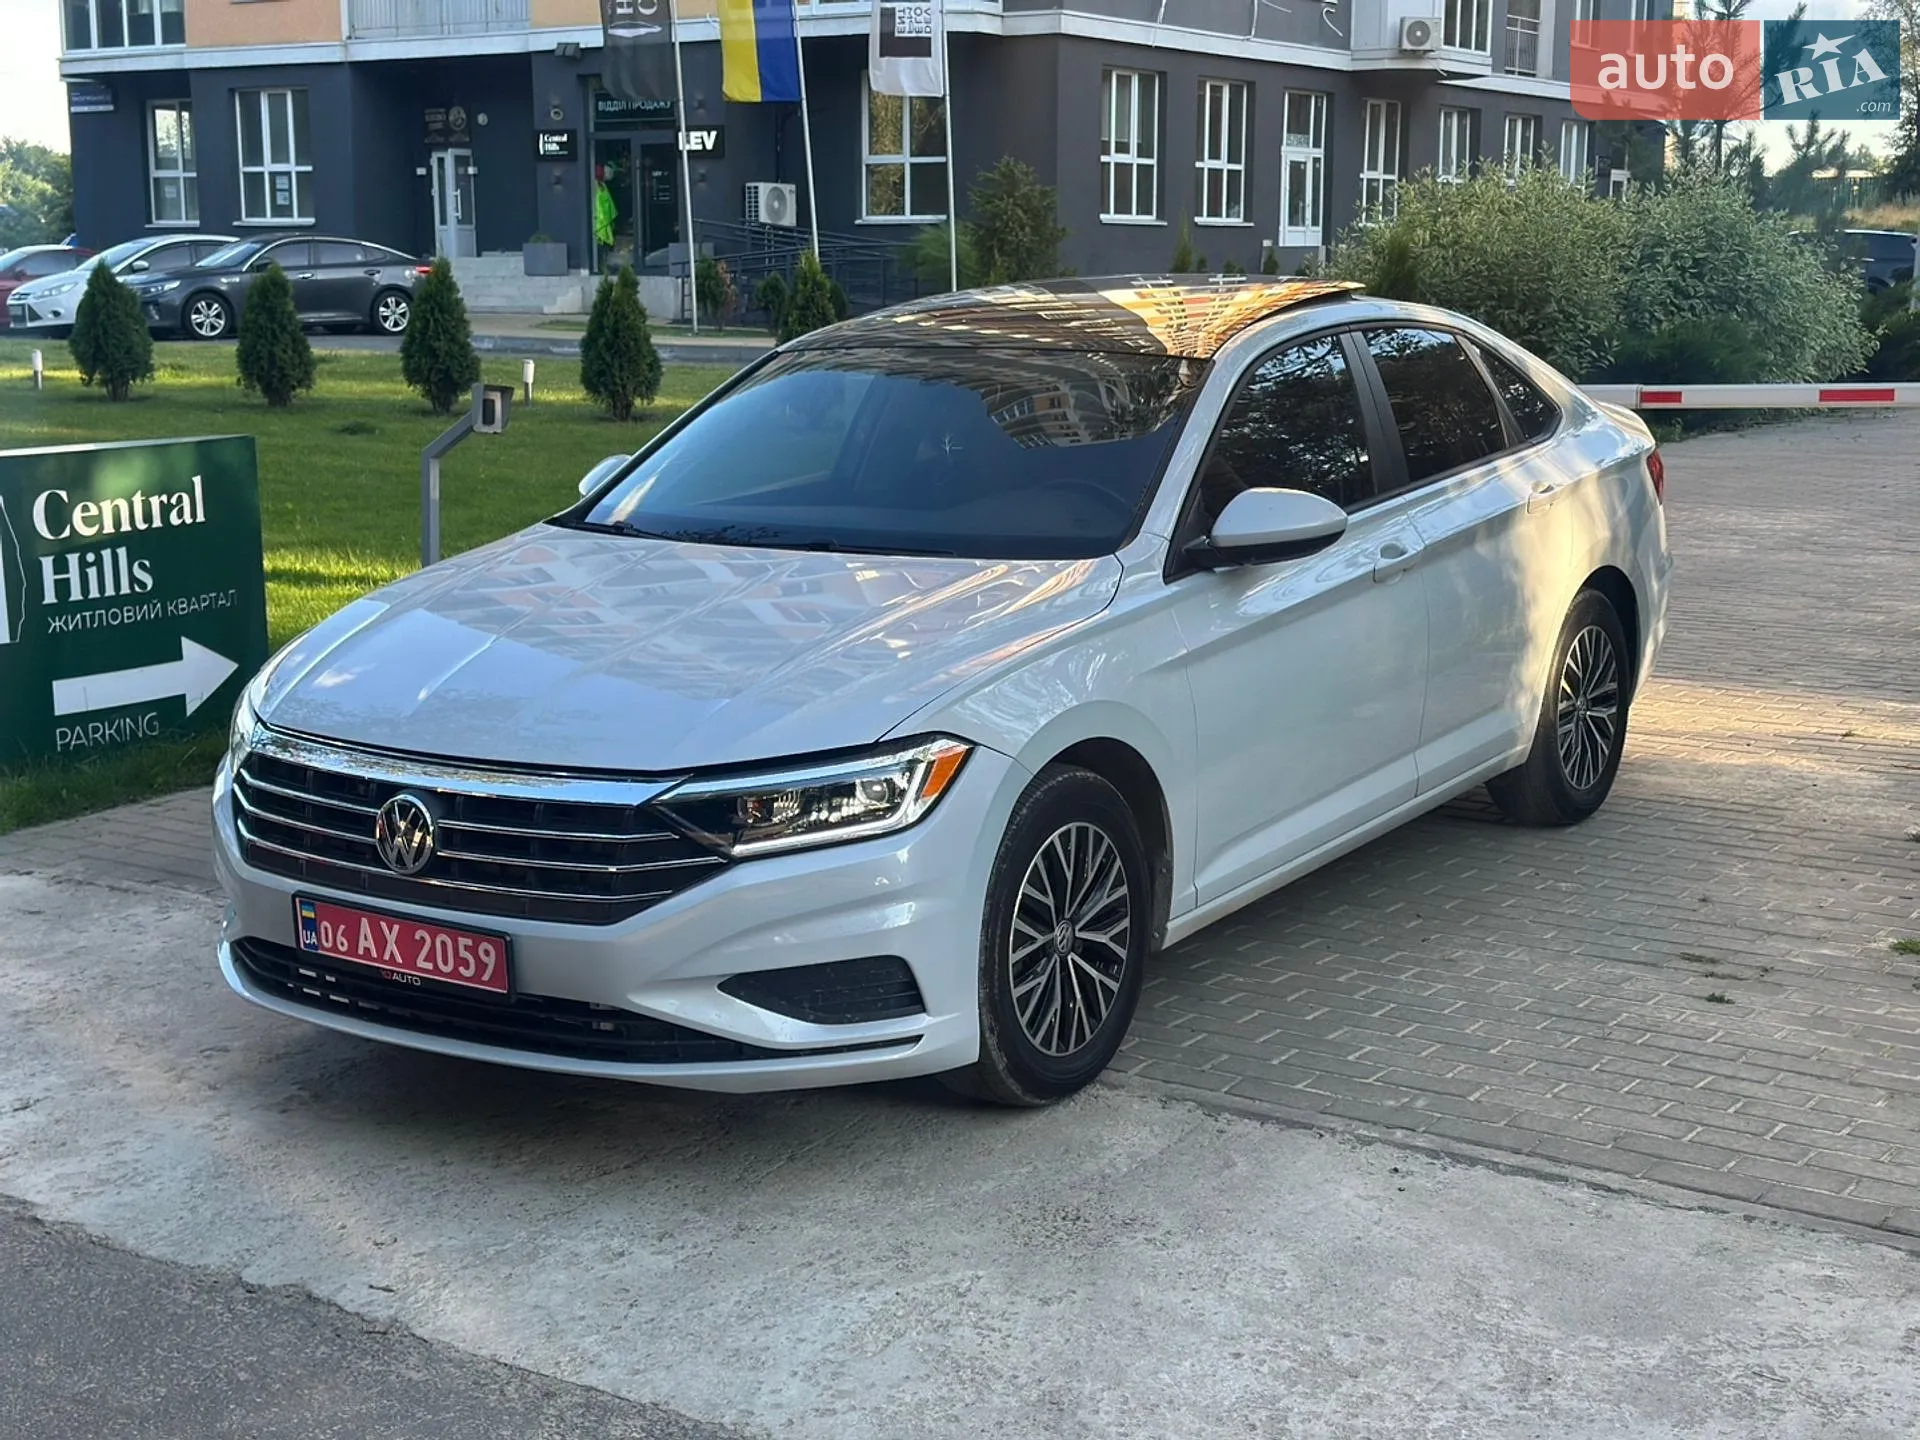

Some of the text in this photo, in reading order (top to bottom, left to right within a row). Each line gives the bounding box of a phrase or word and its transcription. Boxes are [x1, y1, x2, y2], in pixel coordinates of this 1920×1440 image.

[678, 130, 717, 150] LEV
[33, 475, 206, 540] Central
[38, 546, 153, 605] Hills
[48, 589, 237, 634] ЖИТЛОВИЙ КВАРТАЛ
[55, 712, 160, 752] PARKING
[302, 929, 318, 946] UA
[320, 917, 497, 982] 06 AX 2059
